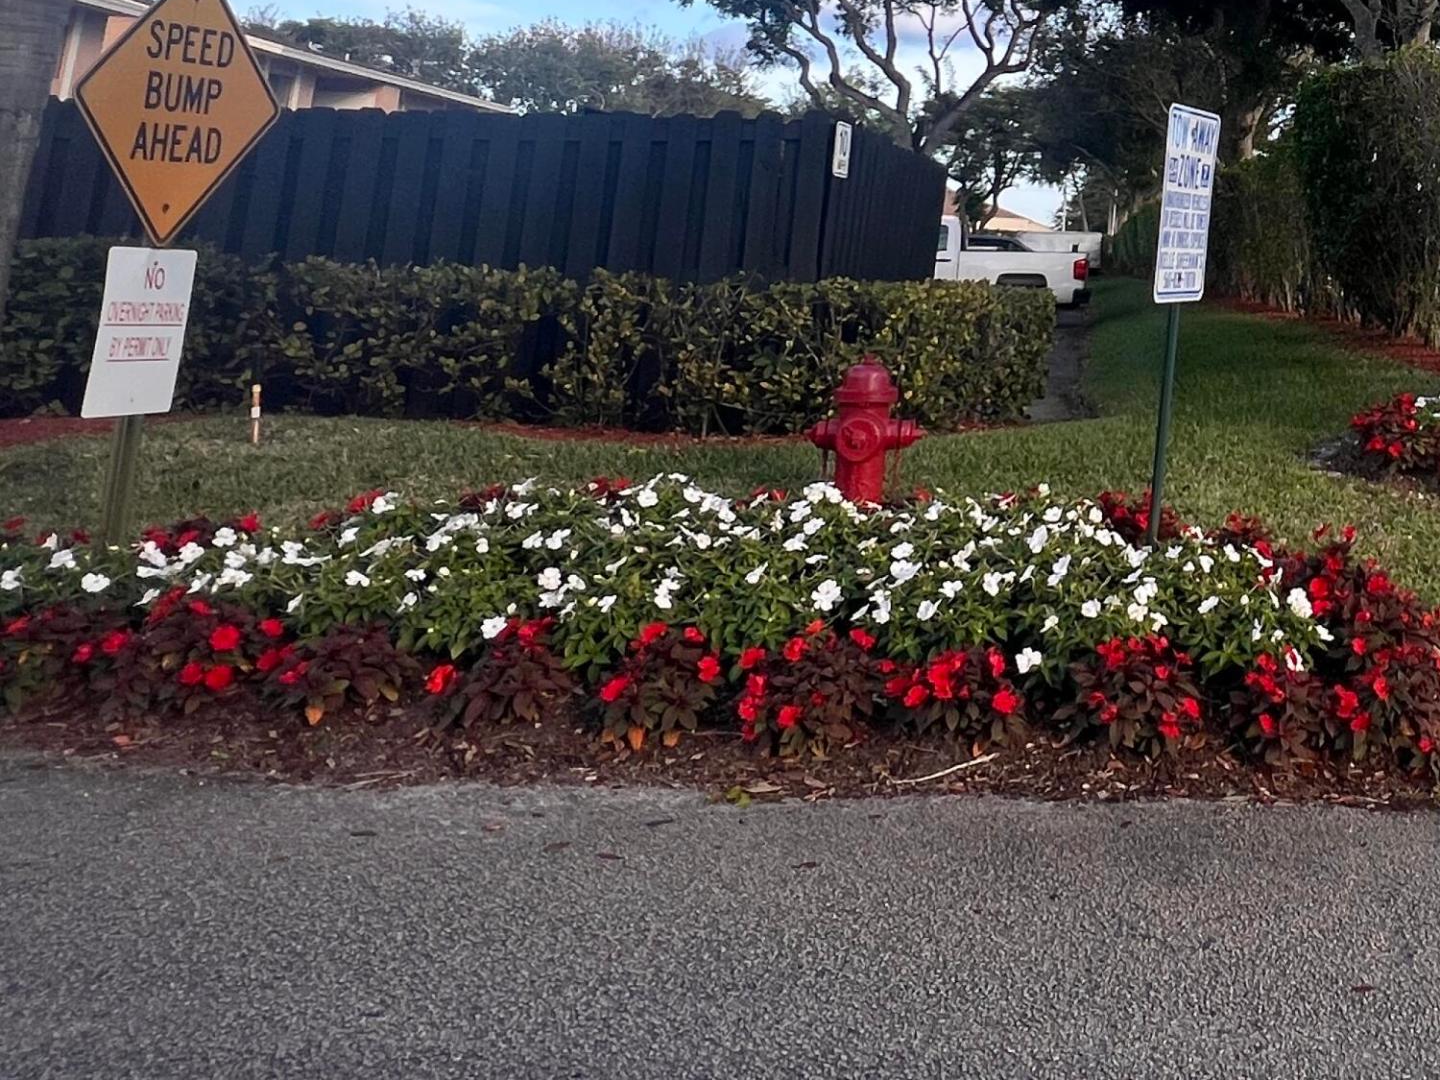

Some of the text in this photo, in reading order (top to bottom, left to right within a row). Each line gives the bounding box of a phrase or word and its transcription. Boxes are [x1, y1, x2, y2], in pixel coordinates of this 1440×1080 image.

[146, 19, 235, 68] SPEED
[144, 70, 223, 115] BUMP
[130, 121, 222, 164] AHEAD
[1178, 154, 1202, 190] ZONE
[144, 267, 165, 290] NO
[107, 301, 185, 322] OVERNIGHT PARKING
[123, 336, 153, 357] PERMIT
